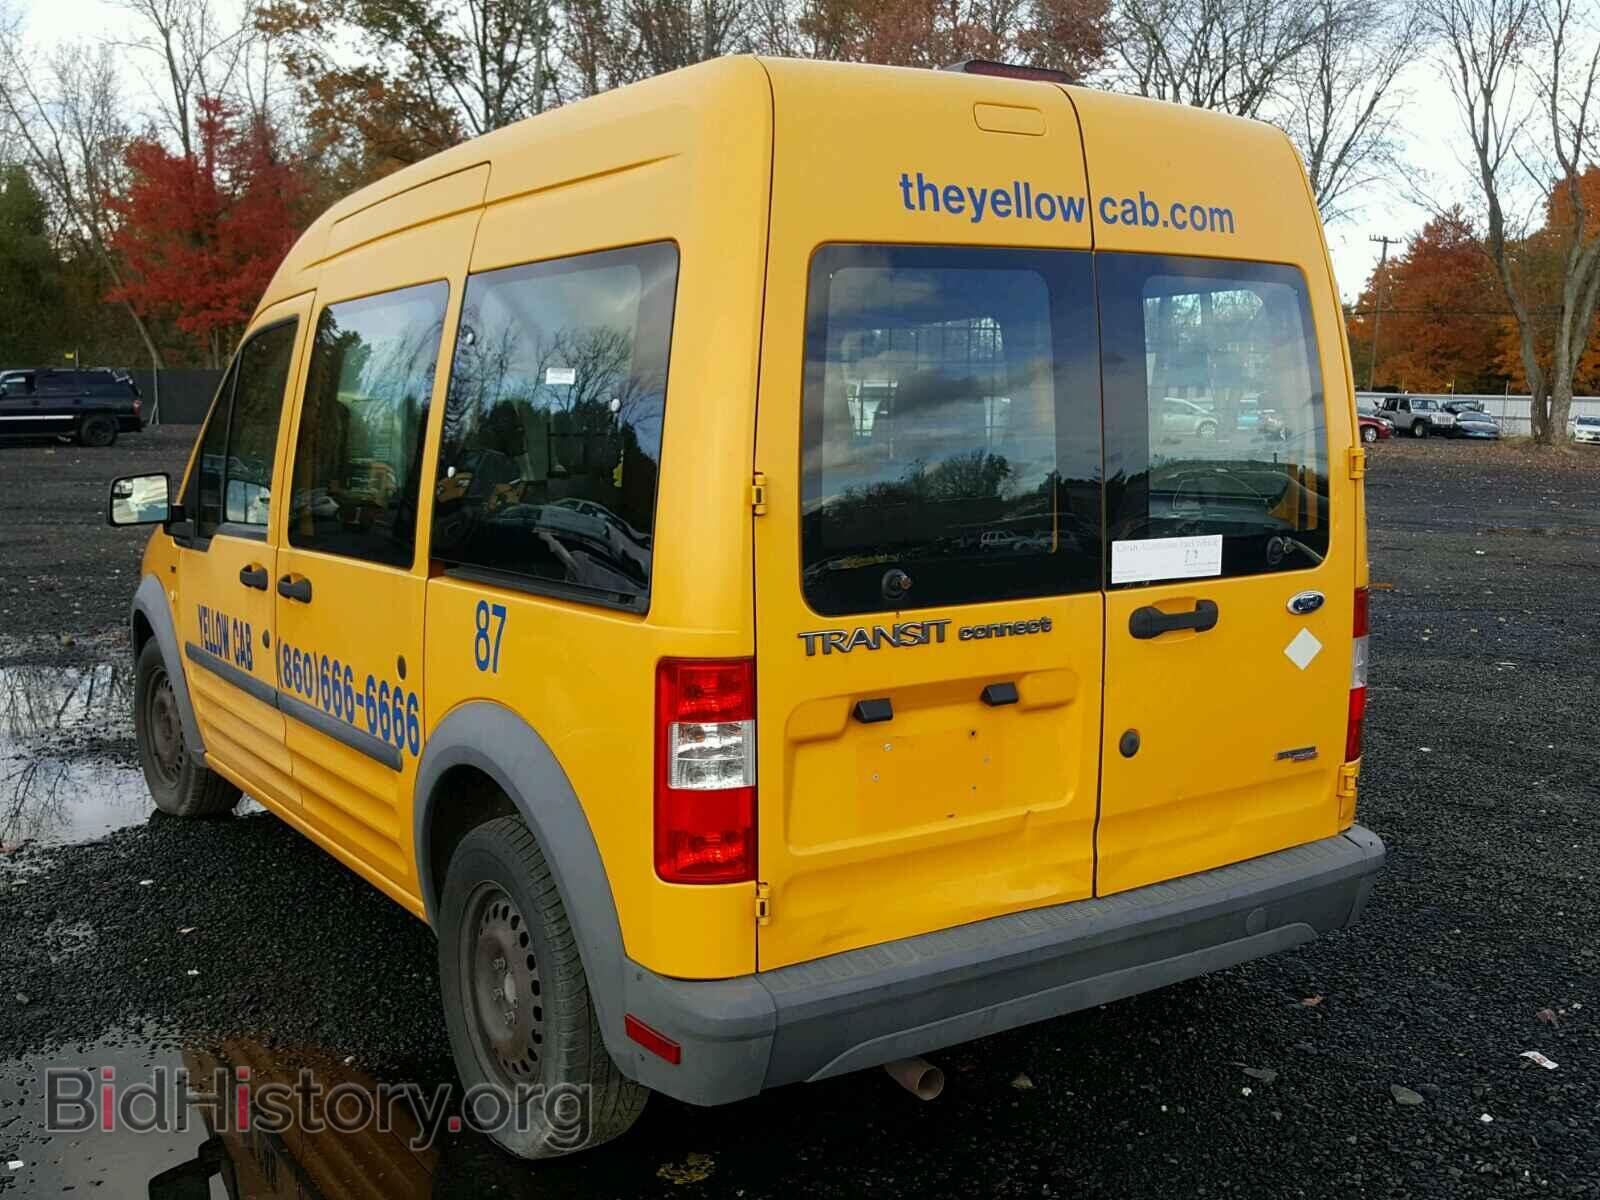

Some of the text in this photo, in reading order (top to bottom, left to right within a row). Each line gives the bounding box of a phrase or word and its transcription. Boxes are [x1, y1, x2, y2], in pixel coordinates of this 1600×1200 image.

[899, 172, 1235, 234] theyellow cab.com
[198, 604, 253, 671] YELLOW CAB
[475, 600, 507, 673] 87
[798, 615, 1052, 656] TRANSIT connect
[276, 636, 420, 758] (860)666-6666
